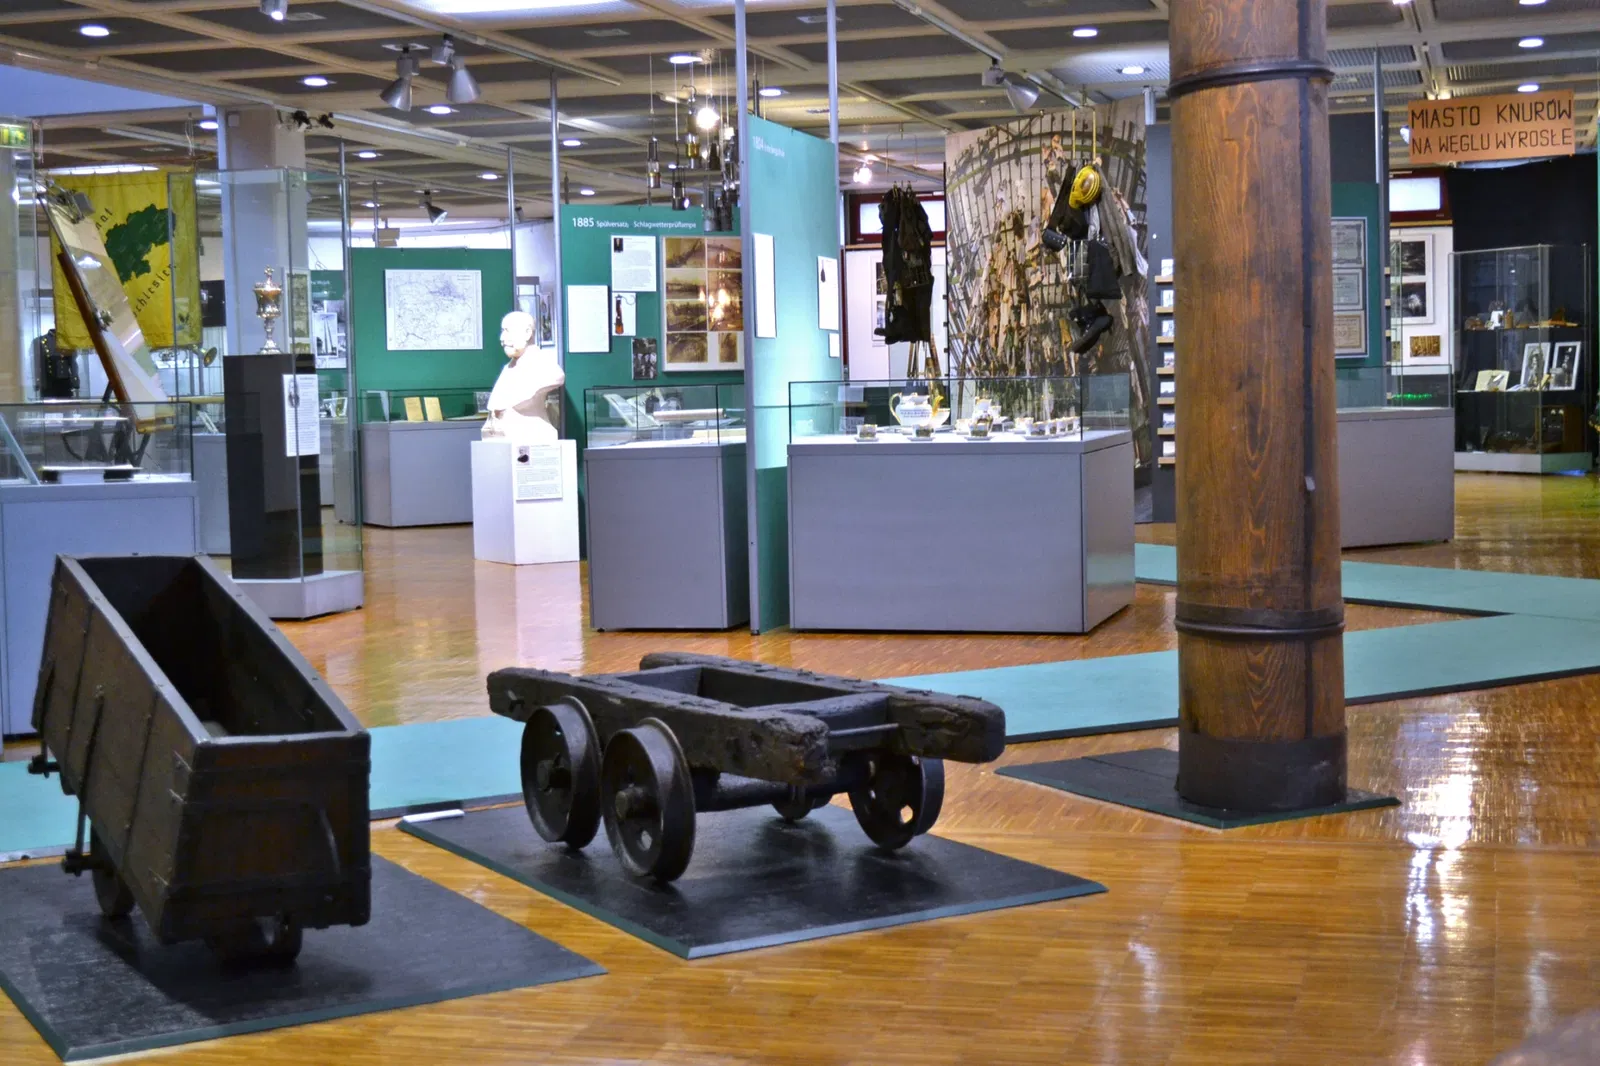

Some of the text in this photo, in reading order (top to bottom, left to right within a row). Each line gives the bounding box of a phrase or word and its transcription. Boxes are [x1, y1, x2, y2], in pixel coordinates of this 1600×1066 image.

[1411, 98, 1572, 129] MIASTO KNURÓW
[1411, 127, 1573, 155] NA WĘGLU WYROSŁE
[572, 217, 595, 227] 1885
